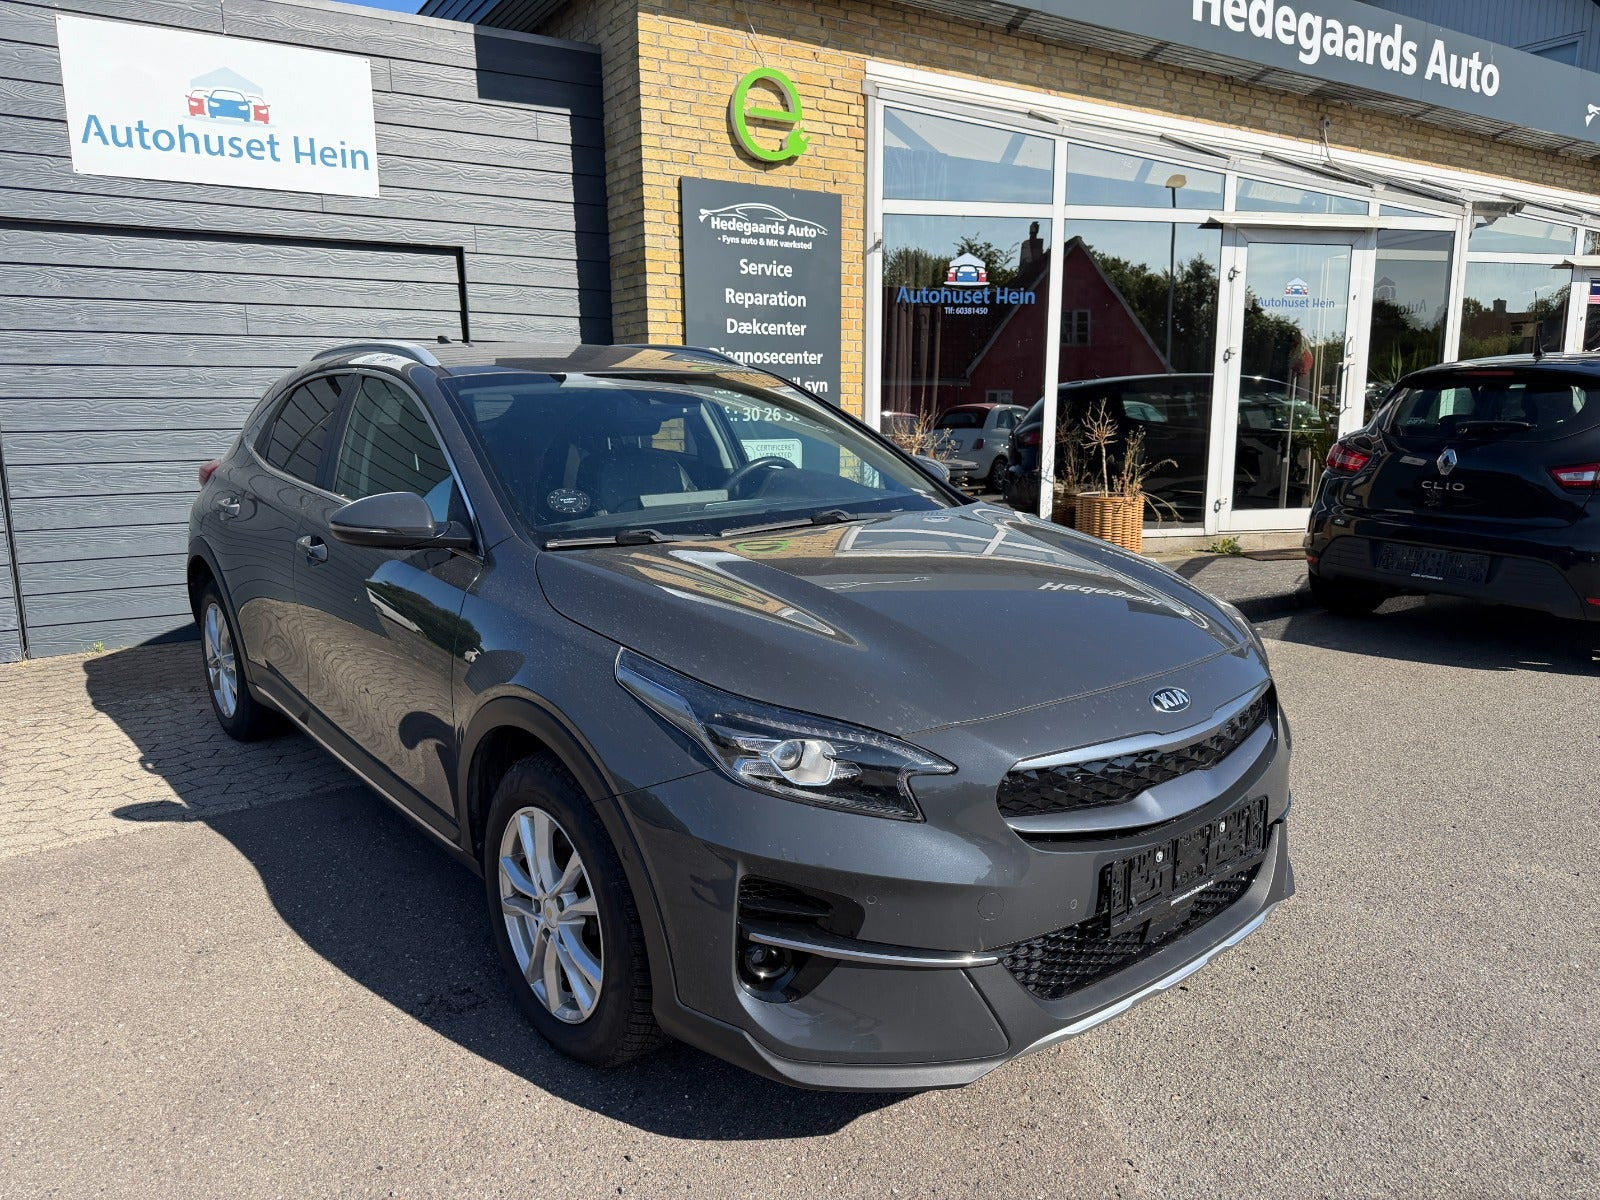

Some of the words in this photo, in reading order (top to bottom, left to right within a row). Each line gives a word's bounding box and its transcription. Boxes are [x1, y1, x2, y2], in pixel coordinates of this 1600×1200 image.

[1424, 38, 1500, 97] Auto
[81, 114, 281, 162] Autohuset
[293, 135, 370, 171] Hein
[711, 216, 785, 236] Hedegaards
[787, 223, 817, 238] Auto
[722, 235, 740, 245] Fyns
[740, 237, 758, 246] auto
[759, 238, 765, 246] &
[766, 239, 779, 247] MX
[780, 240, 812, 250] værksted
[739, 258, 793, 277] Service
[725, 287, 807, 308] Reparation
[896, 286, 990, 304] Autohuset
[996, 287, 1036, 305] Hein
[1257, 296, 1309, 308] Autohuset
[1312, 297, 1336, 308] Hein
[955, 307, 988, 315] 60381450
[726, 318, 807, 336] Dækcenter
[742, 407, 760, 422] 30
[764, 407, 781, 422] 26
[1421, 480, 1465, 491] CLIO
[1154, 689, 1189, 709] KIA
